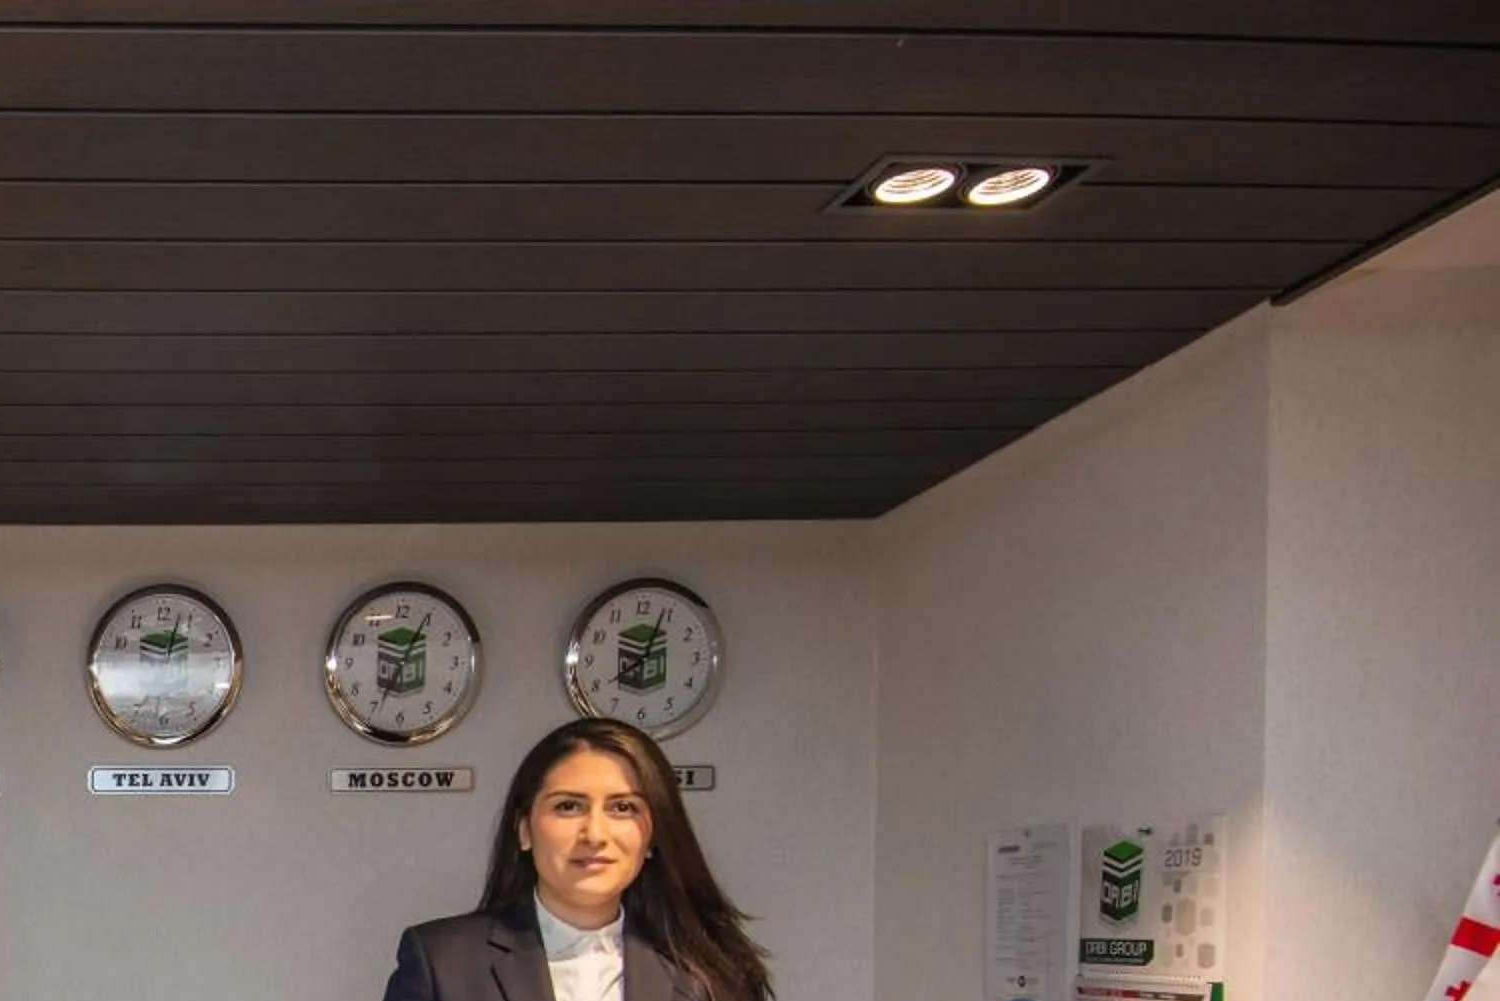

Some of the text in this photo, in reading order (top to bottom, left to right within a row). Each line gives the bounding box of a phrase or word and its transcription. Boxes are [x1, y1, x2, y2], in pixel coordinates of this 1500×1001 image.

[157, 606, 171, 621] 12
[395, 605, 410, 619] 12
[636, 601, 650, 615] 12
[131, 615, 142, 629] 11
[610, 609, 622, 623] 11
[204, 633, 213, 648] 2
[353, 633, 365, 646] 10
[442, 631, 451, 647] 2
[593, 630, 606, 644] 10
[683, 627, 693, 642] 2
[346, 656, 354, 669] 9
[450, 655, 459, 671] 3
[585, 653, 594, 668] 9
[691, 651, 700, 666] 3
[683, 677, 693, 689] 4
[370, 701, 379, 716] 7
[423, 701, 433, 715] 5
[610, 697, 619, 713] 7
[664, 697, 673, 711] 5
[395, 712, 405, 723] 6
[637, 707, 645, 721] 6
[112, 773, 210, 787] TEL AVIV
[348, 771, 454, 788] MOSCOW
[1164, 848, 1202, 867] 2019
[1109, 941, 1147, 957] GROUP
